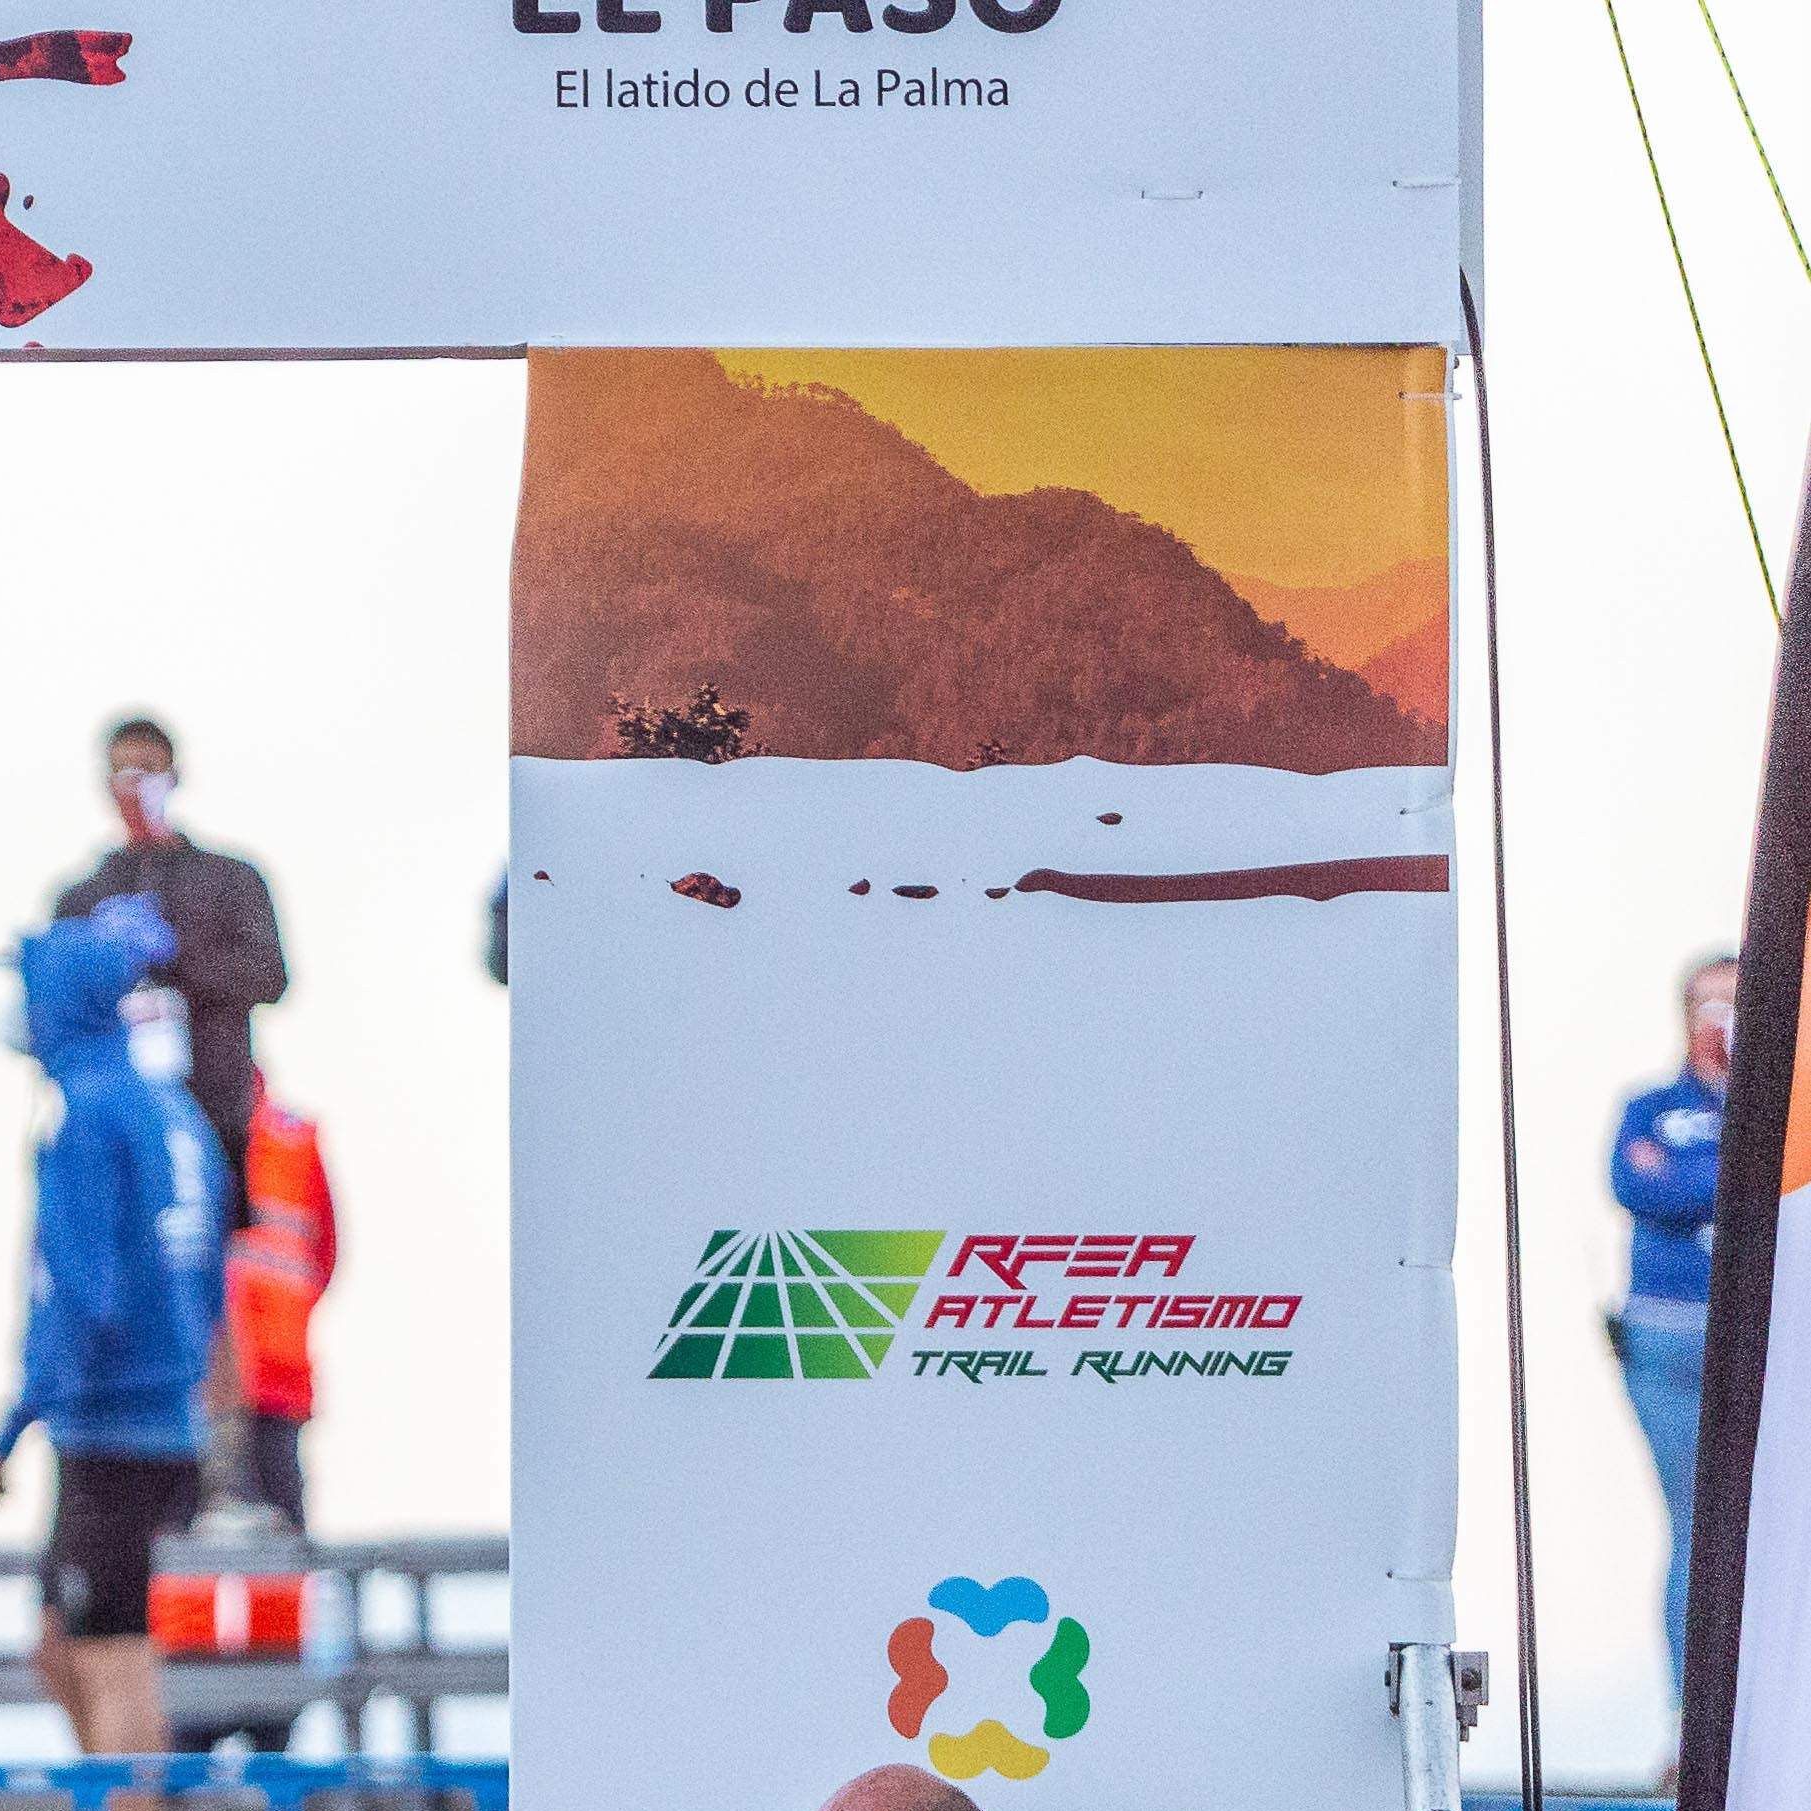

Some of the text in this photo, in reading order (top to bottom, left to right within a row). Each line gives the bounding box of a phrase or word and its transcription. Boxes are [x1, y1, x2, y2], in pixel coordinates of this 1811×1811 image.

[555, 67, 1010, 109] El latido de La Palma
[945, 1233, 1197, 1291] RFEA
[923, 1294, 1303, 1330] ATLETISMO
[910, 1349, 1294, 1385] TRAIL RUNNING
